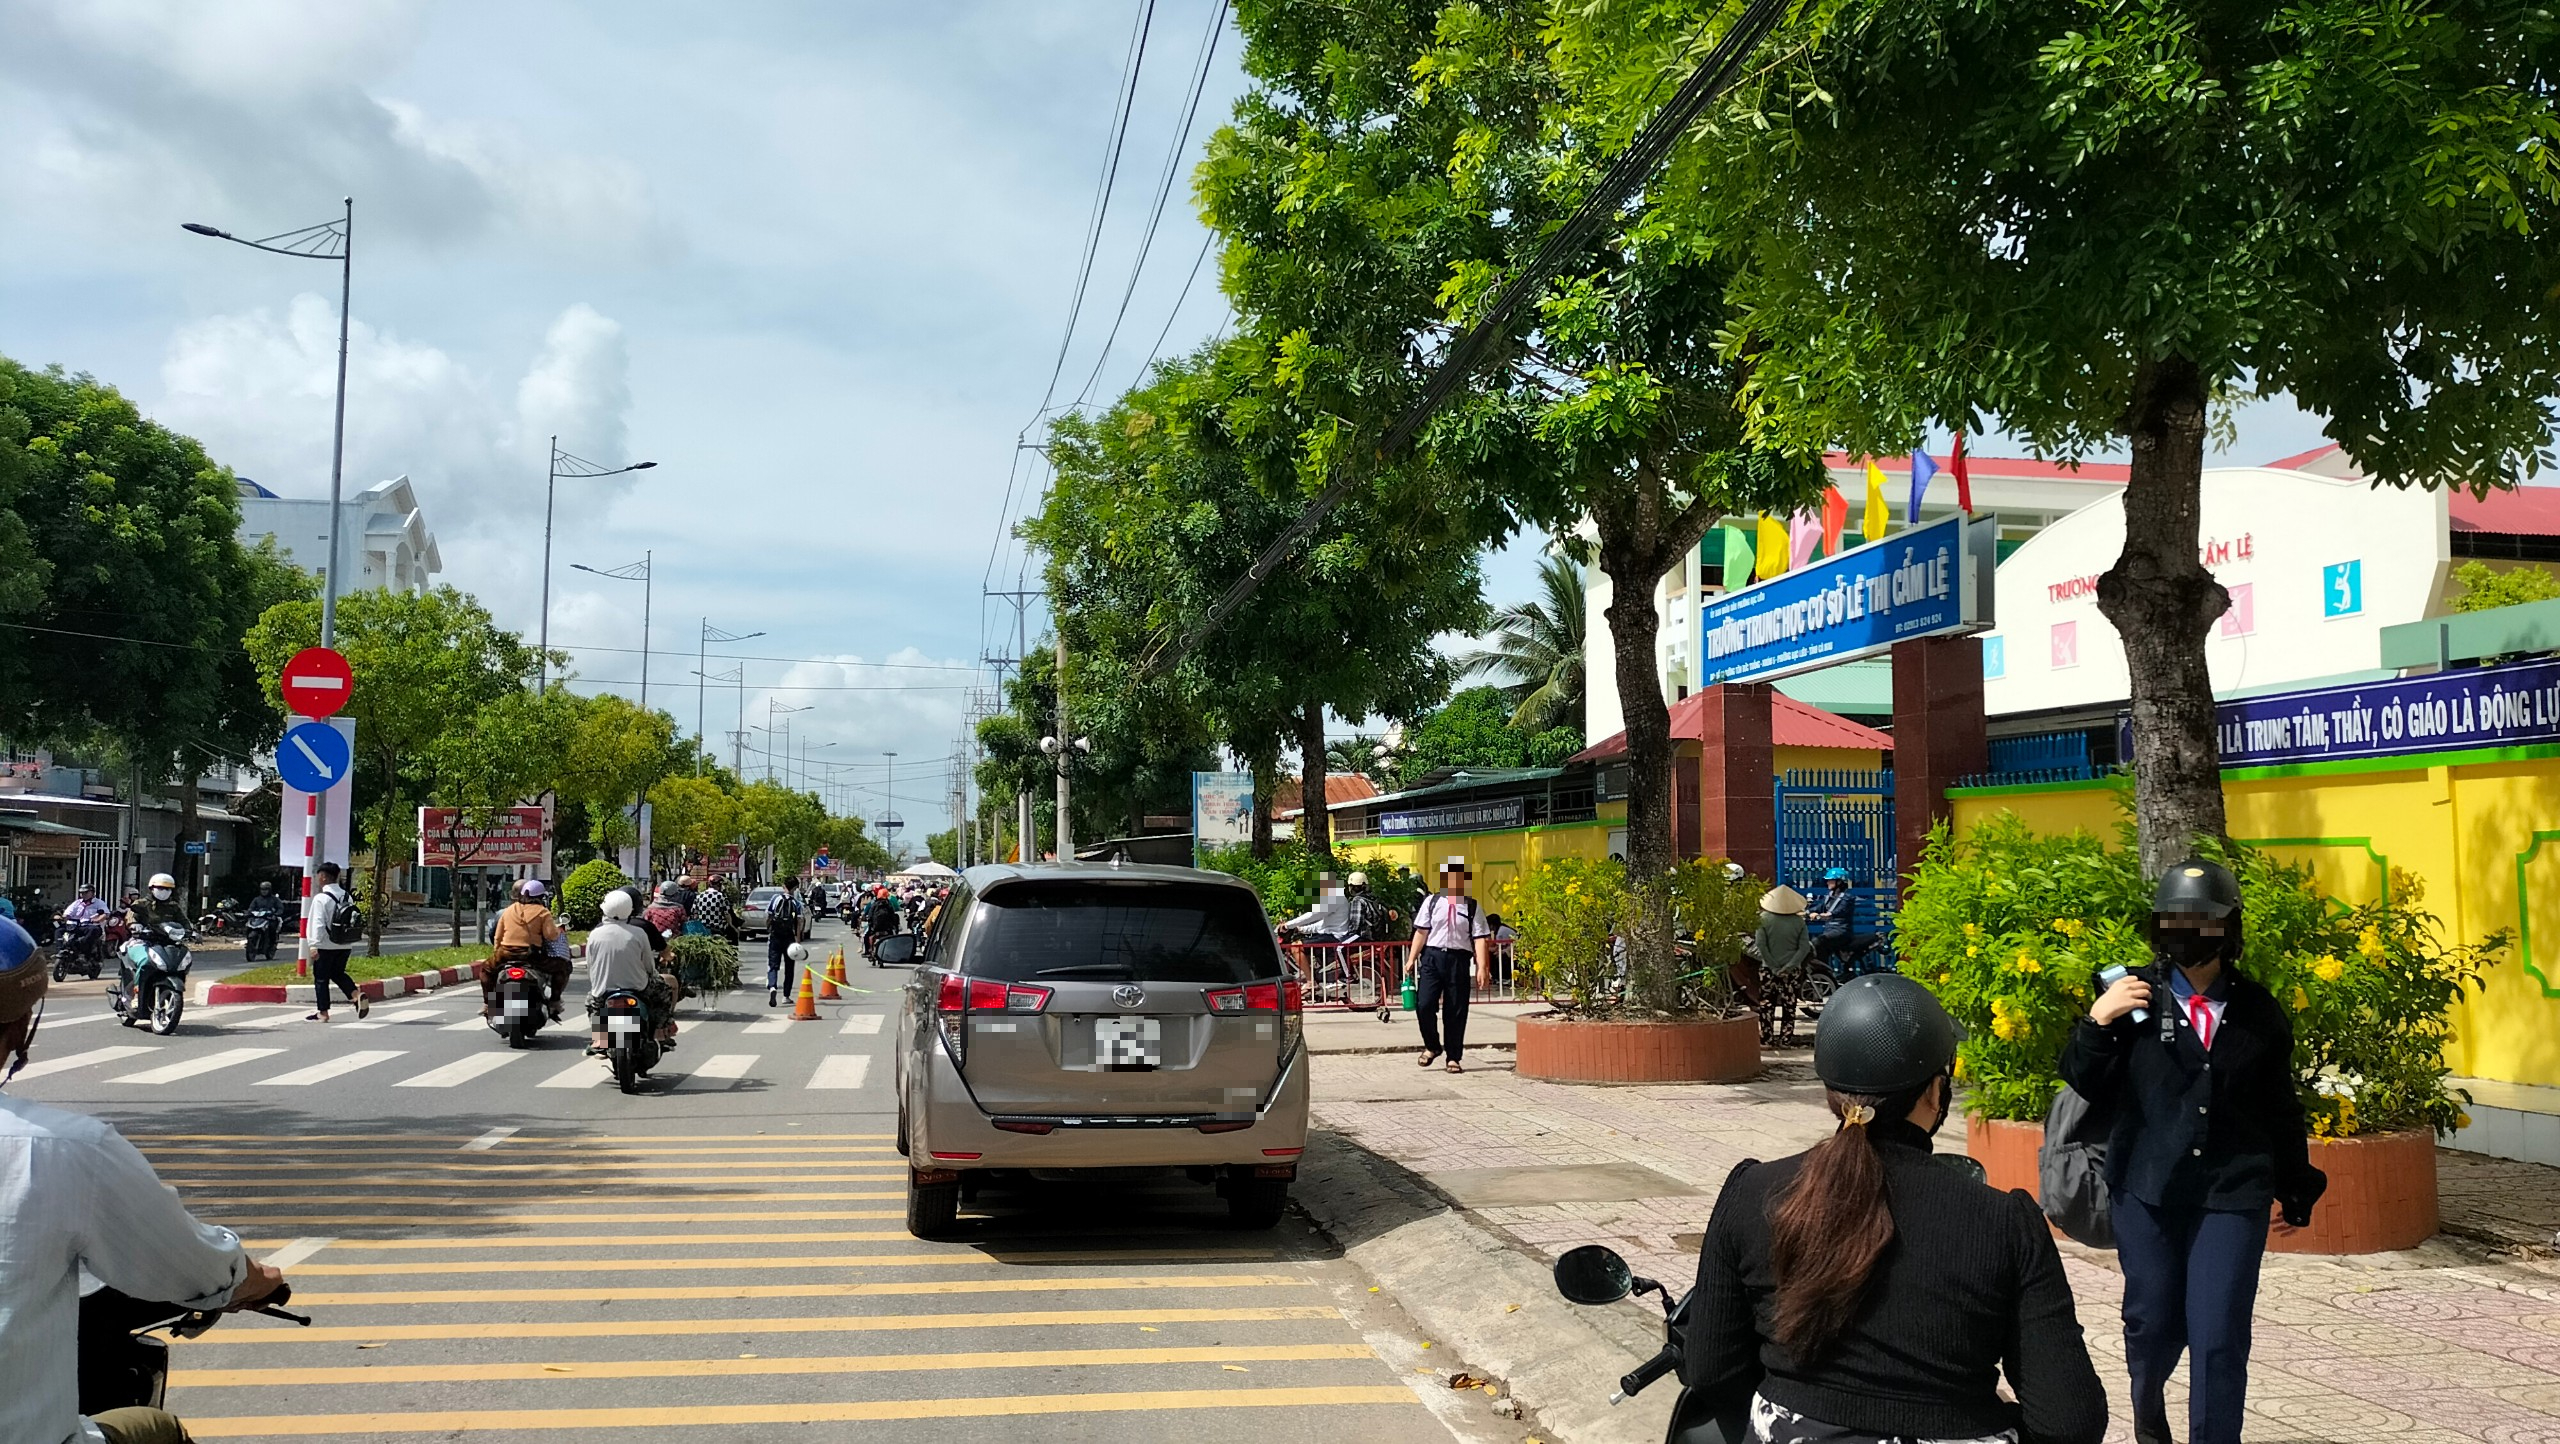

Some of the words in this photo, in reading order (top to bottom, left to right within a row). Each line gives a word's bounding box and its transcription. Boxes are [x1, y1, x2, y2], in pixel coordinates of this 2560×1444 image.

[2199, 536, 2230, 567] ẨM
[1707, 615, 1746, 660] TRƯỜNG
[1746, 607, 1783, 648] TRUNG
[1782, 599, 1807, 642] HỌC
[1807, 588, 1828, 631] CƠ
[1827, 574, 1847, 626] SỞ
[1847, 574, 1866, 620] LÊ
[1866, 573, 1891, 616] THỊ
[1892, 546, 1927, 607] CẨM
[1928, 546, 1950, 601] LỆ
[2226, 715, 2243, 754] LÀ
[2245, 717, 2291, 752] TRUNG
[2292, 706, 2330, 752] TÂM;
[2331, 694, 2378, 748] THẦY,
[2381, 696, 2404, 741] CÔ
[2407, 692, 2448, 738] GIÁO
[2451, 687, 2475, 734] LÀ
[2479, 683, 2531, 737] ĐỘNG
